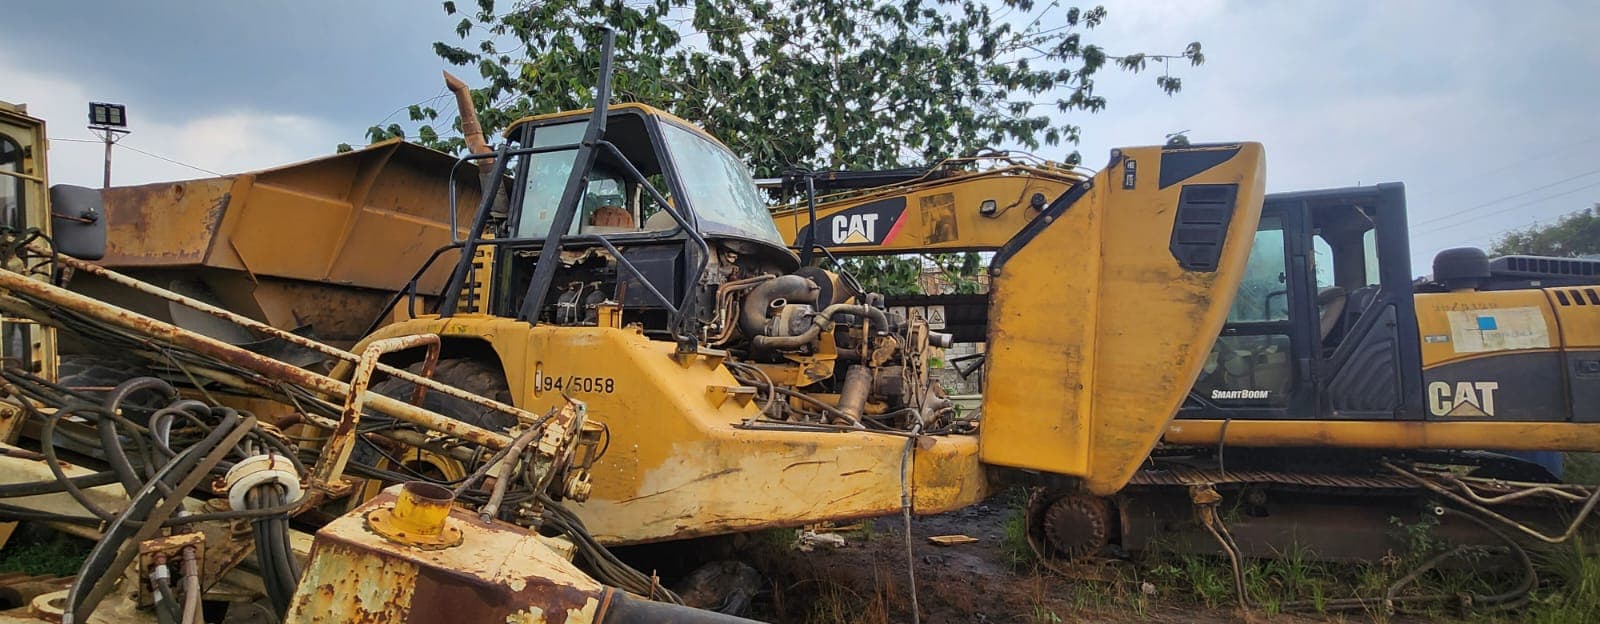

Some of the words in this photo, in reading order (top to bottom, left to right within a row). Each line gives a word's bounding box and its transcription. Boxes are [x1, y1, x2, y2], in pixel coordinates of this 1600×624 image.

[832, 213, 879, 243] CAT
[543, 375, 614, 394] 94/5058
[1428, 381, 1498, 416] CAT
